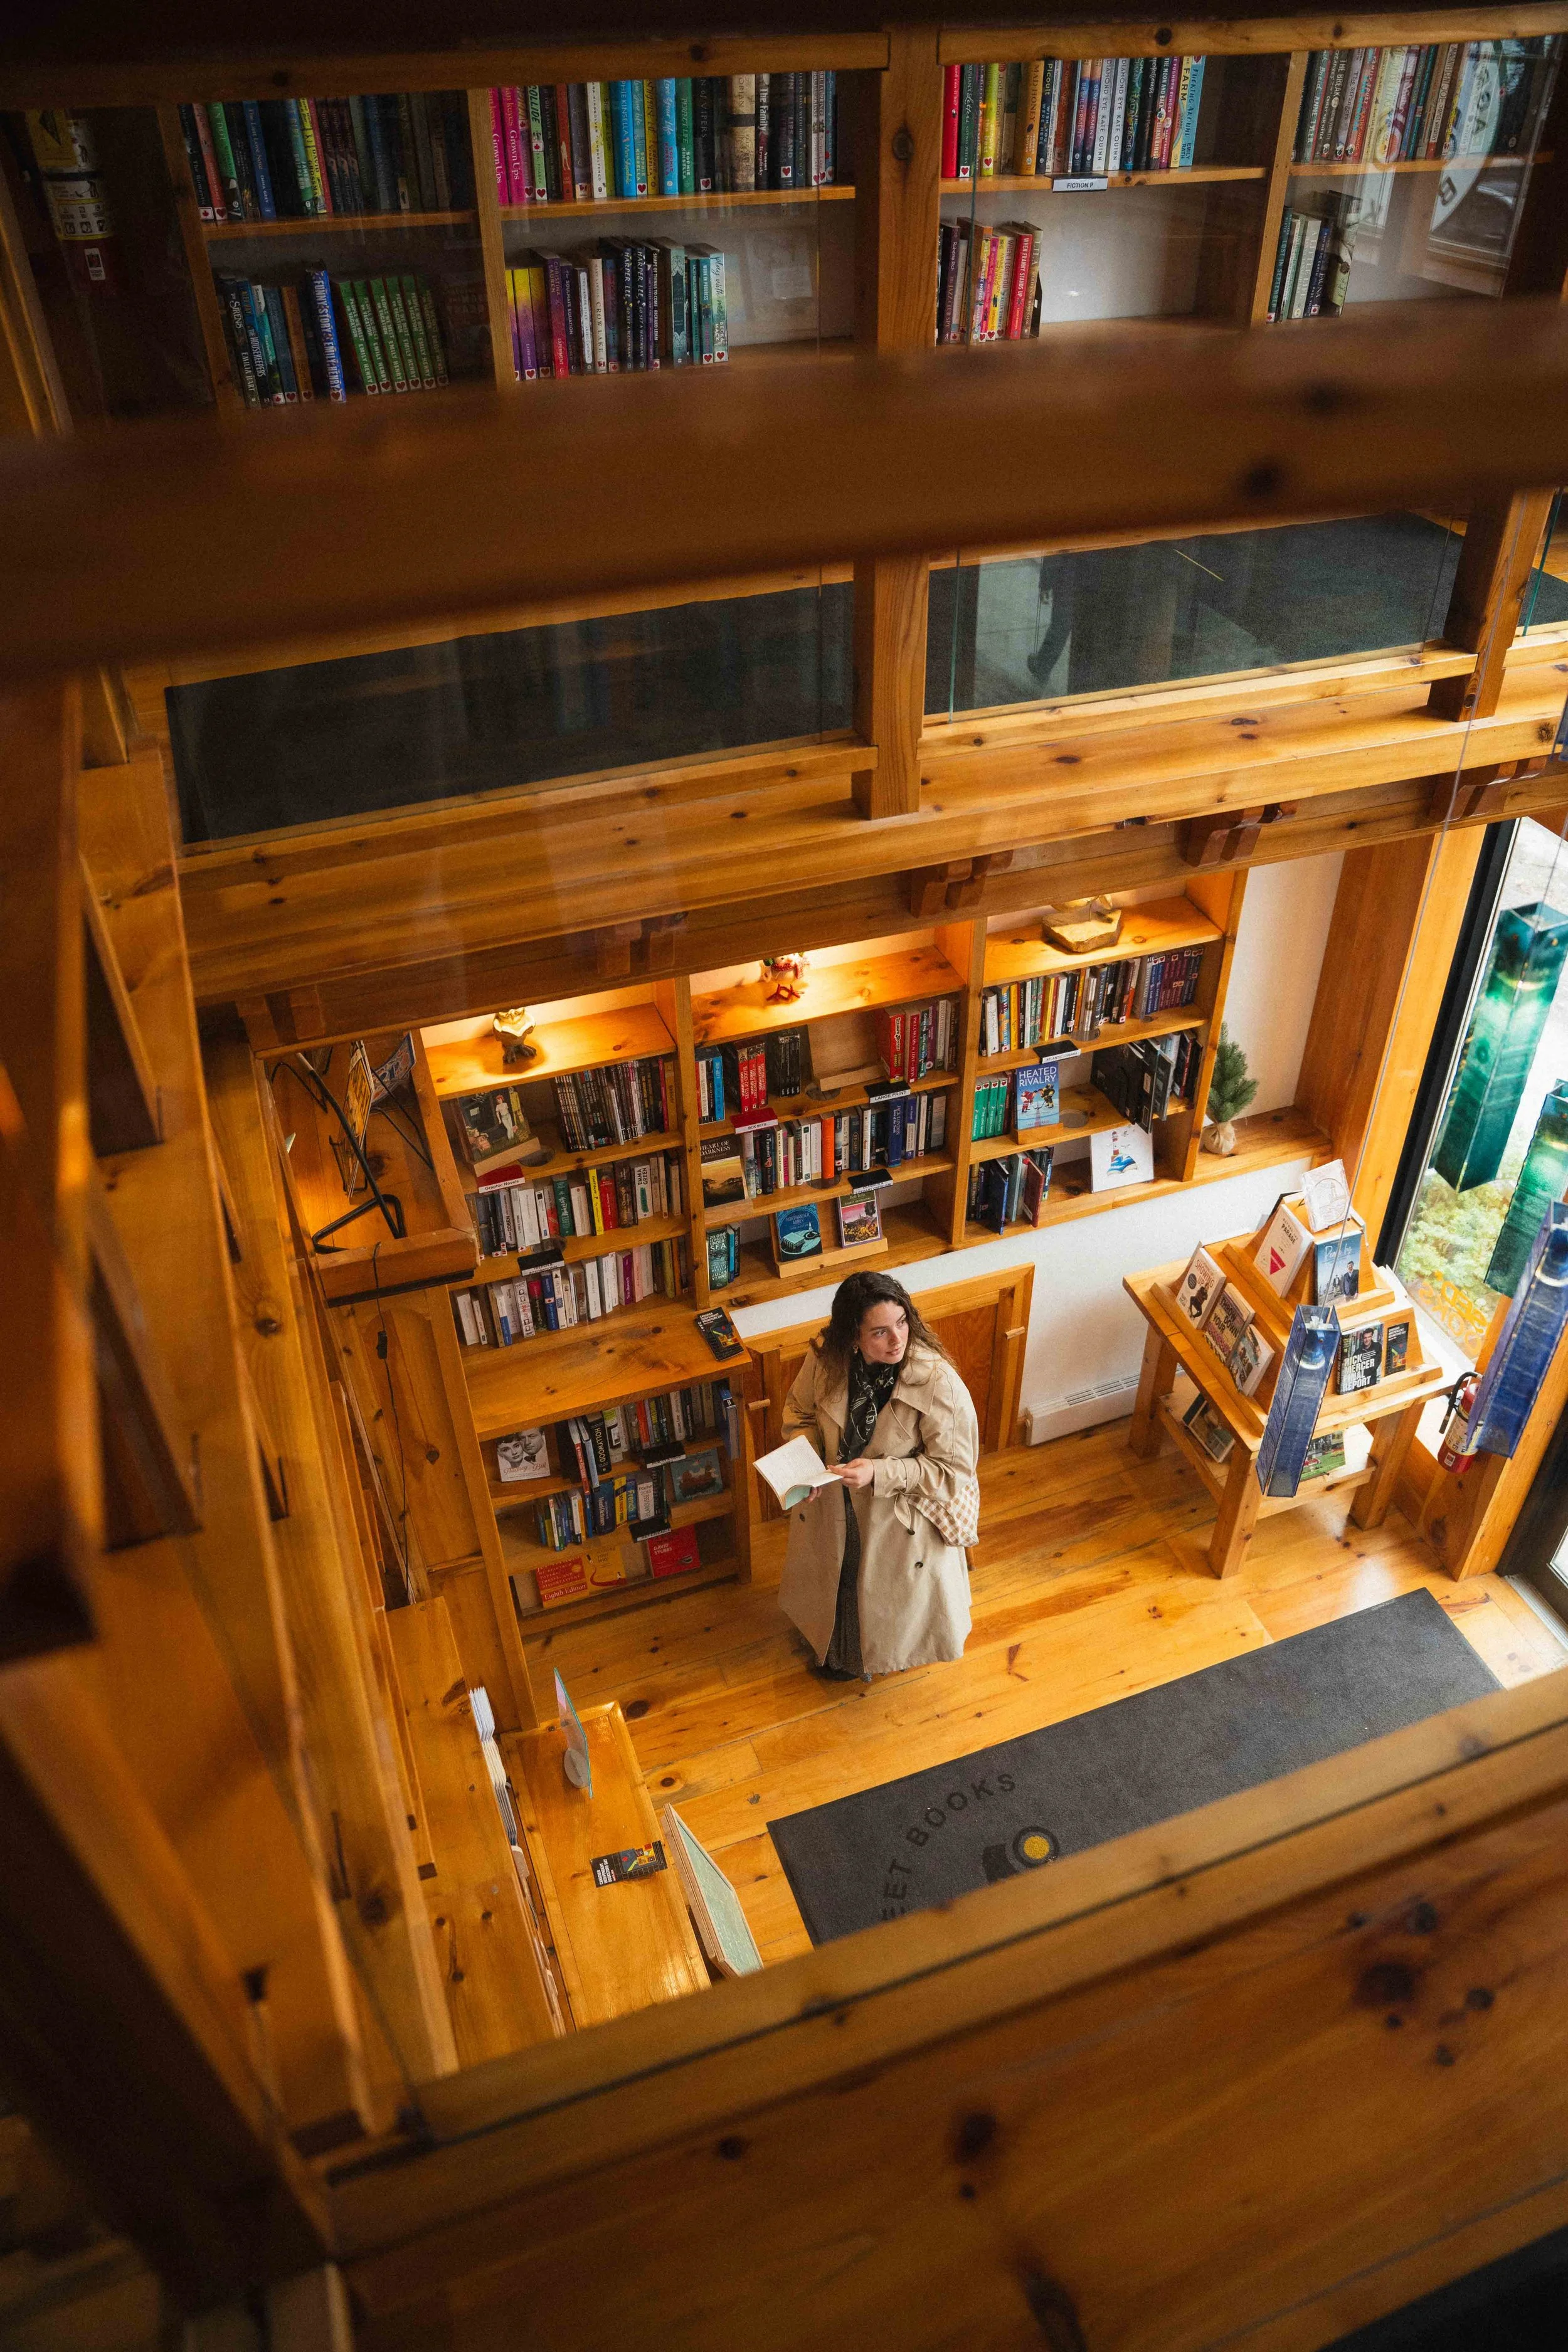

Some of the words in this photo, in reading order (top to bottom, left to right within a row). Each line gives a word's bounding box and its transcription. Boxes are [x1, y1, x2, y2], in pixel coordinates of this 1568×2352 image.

[1031, 64, 1039, 87] MAD
[1338, 58, 1347, 72] THE
[1044, 62, 1053, 95] Picoult
[1103, 60, 1111, 94] DIAMOND
[1118, 60, 1126, 94] DIAMOND
[1179, 67, 1189, 101] FARM
[1332, 72, 1344, 98] BREAK
[760, 88, 769, 103] The
[1029, 89, 1037, 122] HONEY
[1438, 85, 1448, 103] JOE
[620, 100, 629, 135] KINSELLA
[680, 98, 688, 127] PERFECT
[1075, 82, 1088, 138] BEWILDERMENT
[1088, 83, 1098, 140] BEWILDERMENT
[1311, 95, 1320, 117] ANNE
[697, 102, 709, 138] VIPERS
[756, 105, 769, 131] Family
[252, 137, 262, 153] Love
[491, 133, 502, 163] Grown
[507, 129, 520, 161] Grown
[1111, 134, 1120, 161] QUINN
[1125, 122, 1133, 152] TEACHER
[312, 149, 320, 172] DAVID
[511, 162, 522, 180] Ups
[494, 165, 503, 183] Ups
[1019, 253, 1027, 271] FRANNY
[1030, 240, 1040, 267] LILA
[1278, 258, 1284, 267] IN
[1017, 272, 1025, 290] STANDS
[1271, 268, 1282, 308] SEPTEMBER
[1313, 272, 1327, 299] FAUNA
[313, 279, 328, 307] FUNNY
[564, 279, 572, 307] SOULMATE
[228, 299, 244, 329] SIRENS
[317, 307, 332, 334] STORY
[248, 336, 267, 378] HOUSEKEEPERS
[322, 340, 338, 364] EMILY
[357, 342, 368, 362] EMILY
[387, 340, 398, 359] EMILY
[402, 338, 412, 358] EMILY
[240, 351, 252, 374] EMILIA
[371, 341, 383, 361] EMILY
[377, 361, 388, 382] HENRY
[392, 360, 403, 381] HENRY
[245, 374, 255, 392] HART
[326, 365, 342, 390] HENRY
[362, 363, 373, 384] HENRY
[1046, 1054, 1062, 1062] ATLANTIC
[1019, 1066, 1057, 1079] HEATED
[1019, 1074, 1056, 1087] RIVALRY
[700, 1143, 719, 1151] HEART
[700, 1145, 731, 1156] DARKNESS
[785, 1213, 810, 1222] NORTHANGER
[1281, 1224, 1296, 1245] PARADE
[710, 1242, 726, 1251] SEA
[1195, 1259, 1215, 1288] SHOWING
[1197, 1278, 1205, 1288] UP
[1220, 1297, 1237, 1322] THROW
[1213, 1312, 1226, 1334] YOUR
[1224, 1314, 1239, 1338] DOWN
[1343, 1353, 1362, 1366] RICK
[1343, 1358, 1375, 1374] MERCER
[1342, 1375, 1372, 1391] REPORT
[593, 1427, 607, 1463] HOLLYWOOD
[626, 1490, 635, 1512] French
[654, 1543, 669, 1551] DAVID
[654, 1547, 673, 1555] STUBBS
[544, 1589, 564, 1600] Eighth
[564, 1583, 586, 1594] Edition
[905, 1772, 1017, 1848] BOOKS
